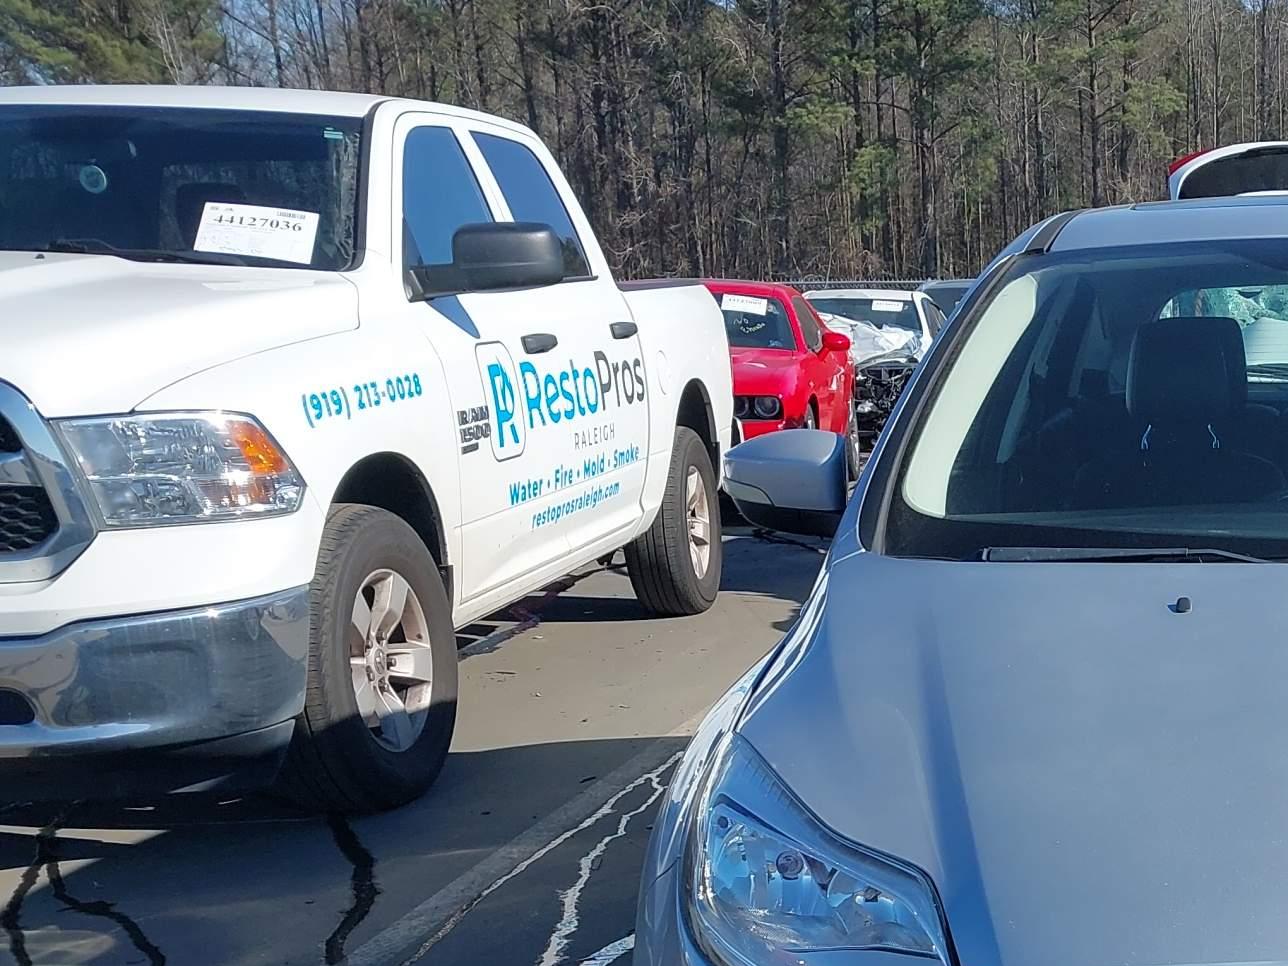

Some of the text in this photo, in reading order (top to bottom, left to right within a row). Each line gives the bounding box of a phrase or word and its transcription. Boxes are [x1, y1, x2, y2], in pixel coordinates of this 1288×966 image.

[213, 215, 302, 232] 44127036
[302, 373, 422, 428] (919) 213-0028
[519, 350, 645, 429] RestoPros
[457, 405, 489, 426] RAM
[459, 422, 491, 443] 1500
[574, 423, 616, 450] RALEIGH
[509, 442, 639, 506] Water Fire Mold Smoke
[531, 481, 620, 529] restoprosraleigh.com
